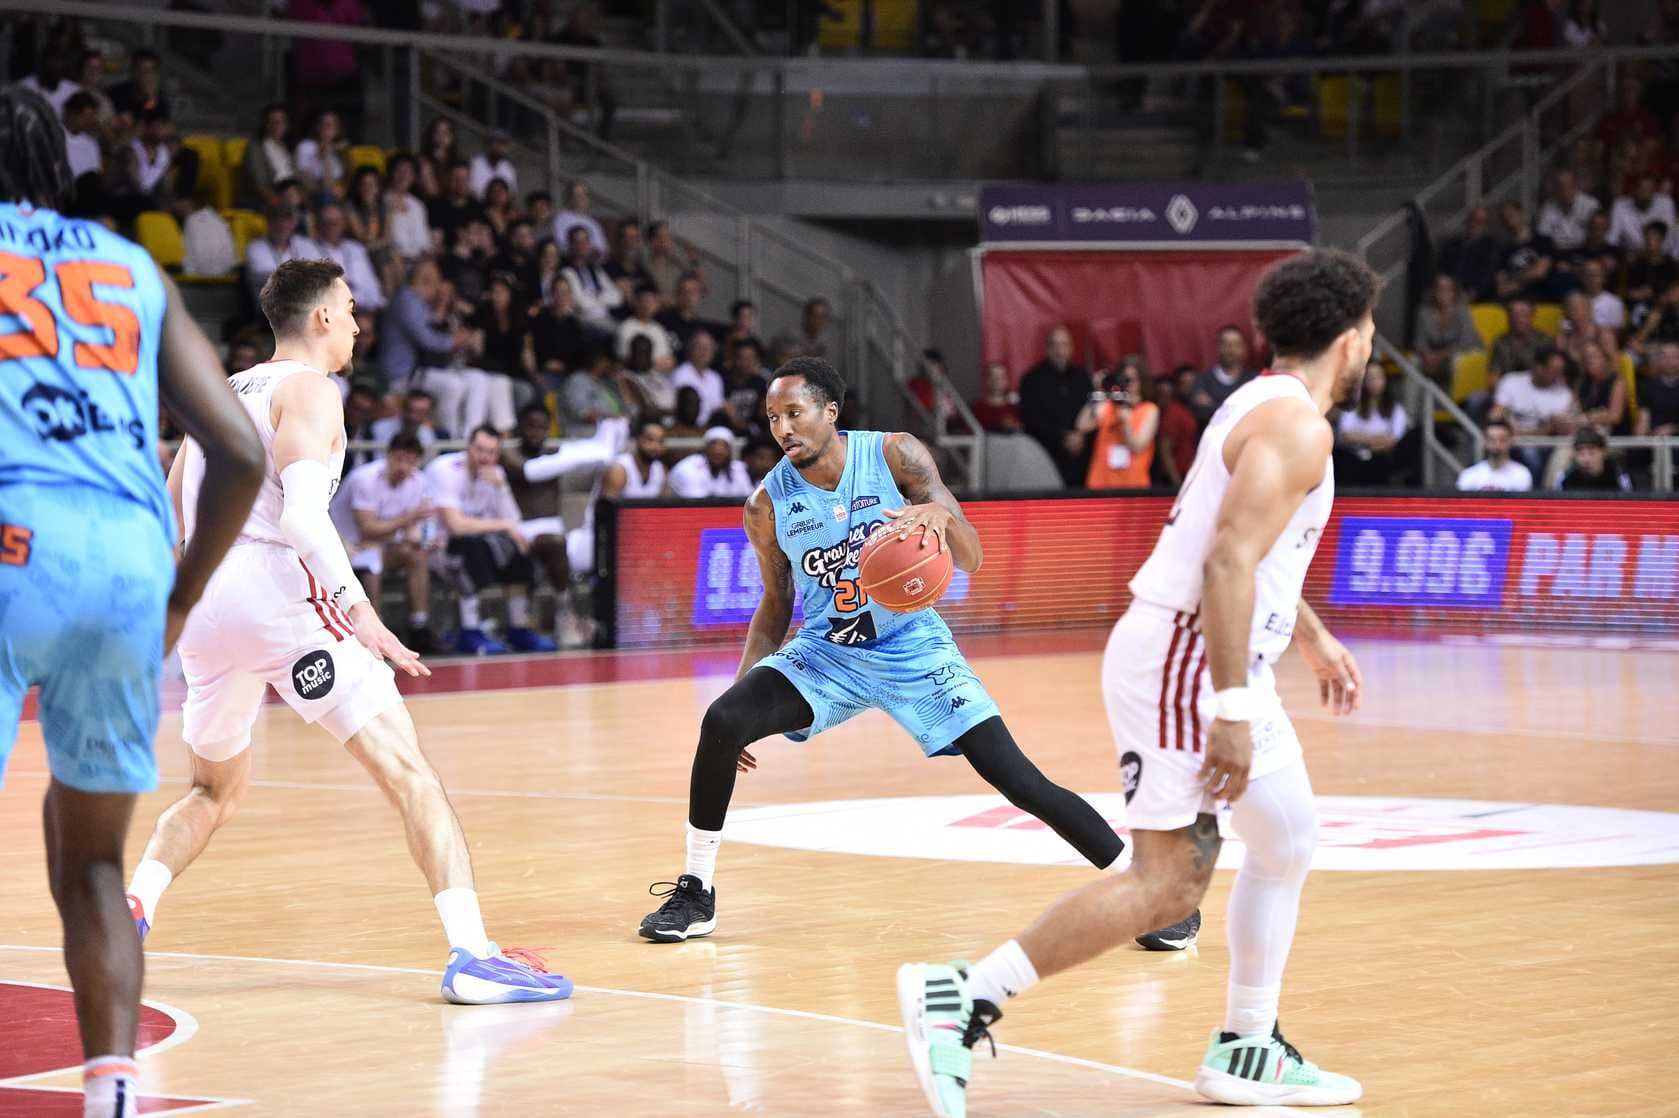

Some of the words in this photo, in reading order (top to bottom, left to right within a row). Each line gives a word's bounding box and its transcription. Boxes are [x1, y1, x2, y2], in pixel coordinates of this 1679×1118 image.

[0, 250, 141, 376] 35
[786, 521, 825, 537] LEMPEREUR
[1519, 532, 1628, 598] PAR
[834, 576, 869, 612] 21
[295, 657, 327, 688] TOP
[301, 670, 332, 695] music
